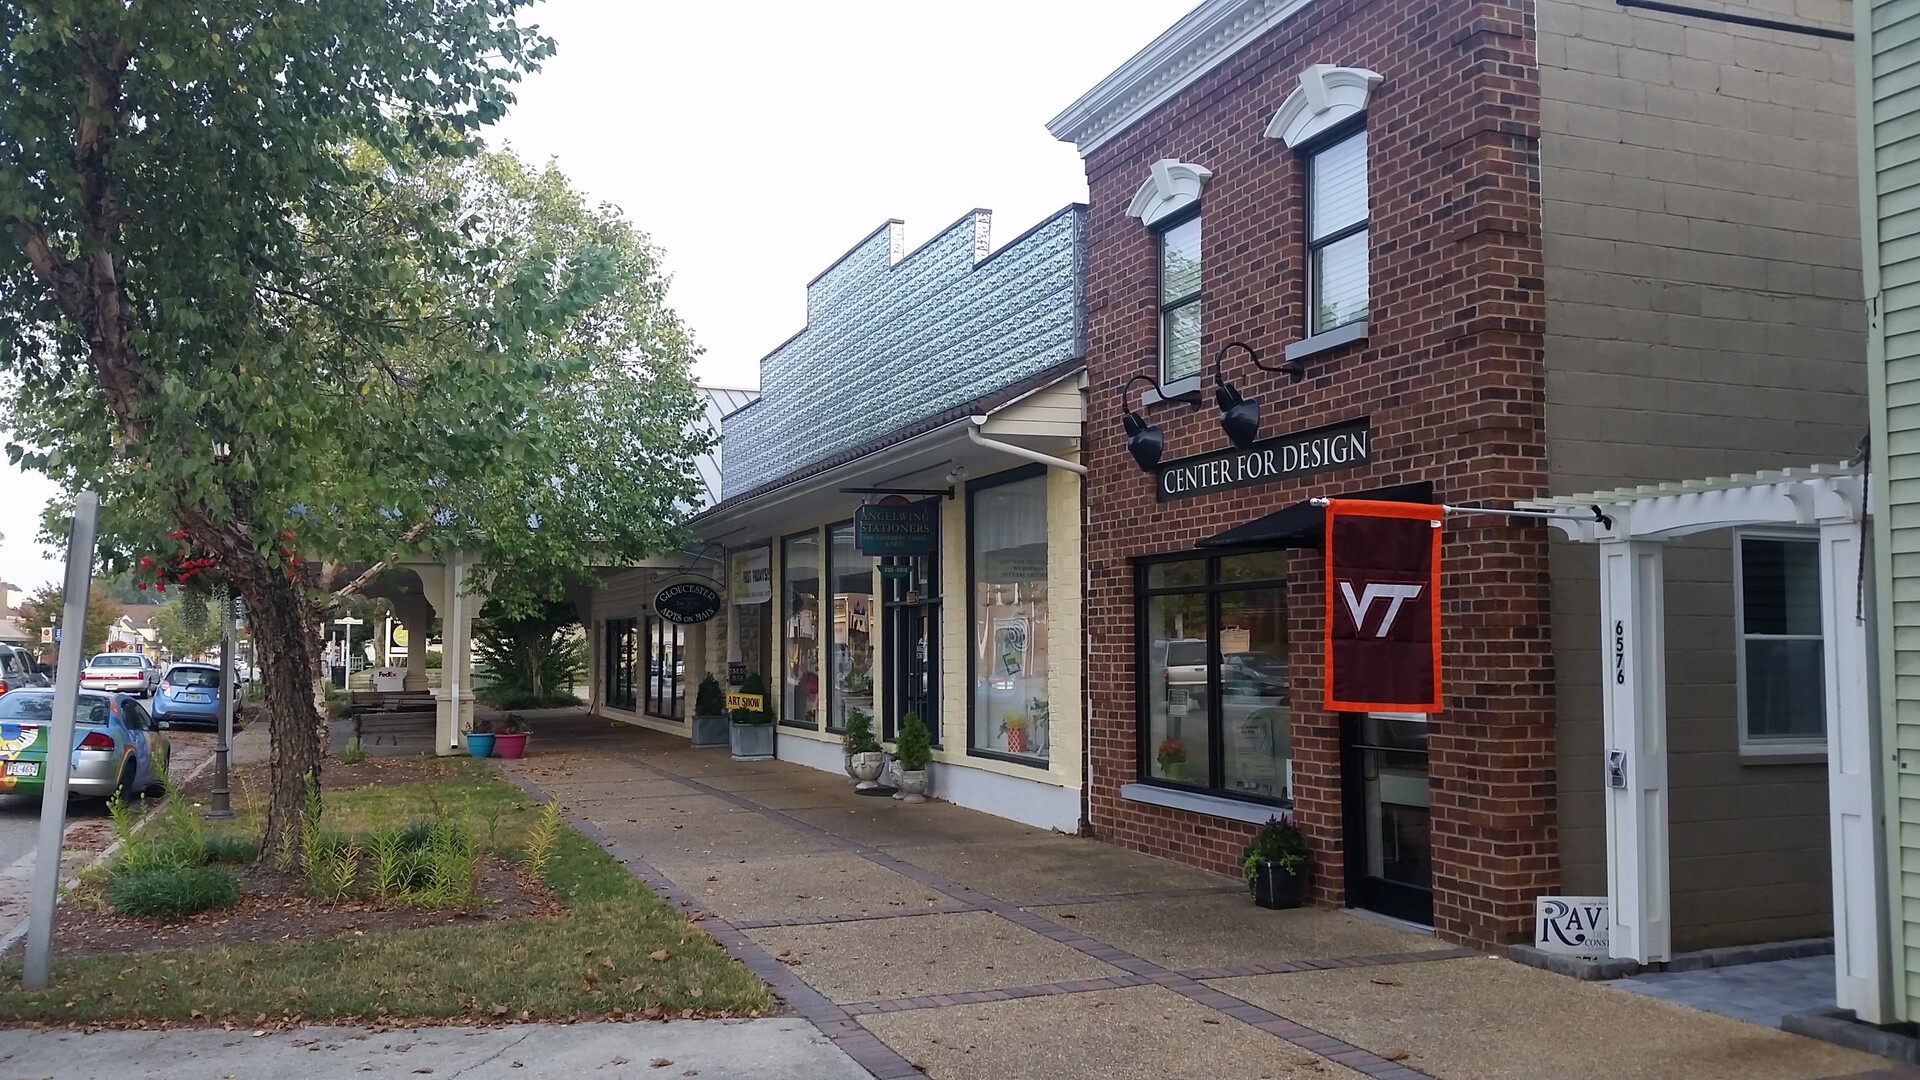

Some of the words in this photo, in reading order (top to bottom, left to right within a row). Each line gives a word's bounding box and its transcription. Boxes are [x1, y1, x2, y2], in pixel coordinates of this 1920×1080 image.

[1164, 459, 1233, 494] CENTER
[1237, 449, 1278, 481] FOR
[1282, 430, 1368, 473] DESIGN
[861, 511, 929, 521] ANGELWING
[861, 523, 930, 534] STATIONERS
[660, 585, 716, 601] GLOUCESTER
[660, 608, 682, 622] ARTS
[695, 607, 715, 621] MAIN
[1337, 580, 1425, 638] VT
[1616, 620, 1625, 685] 6576
[728, 696, 740, 706] ART
[742, 697, 760, 708] SHOW
